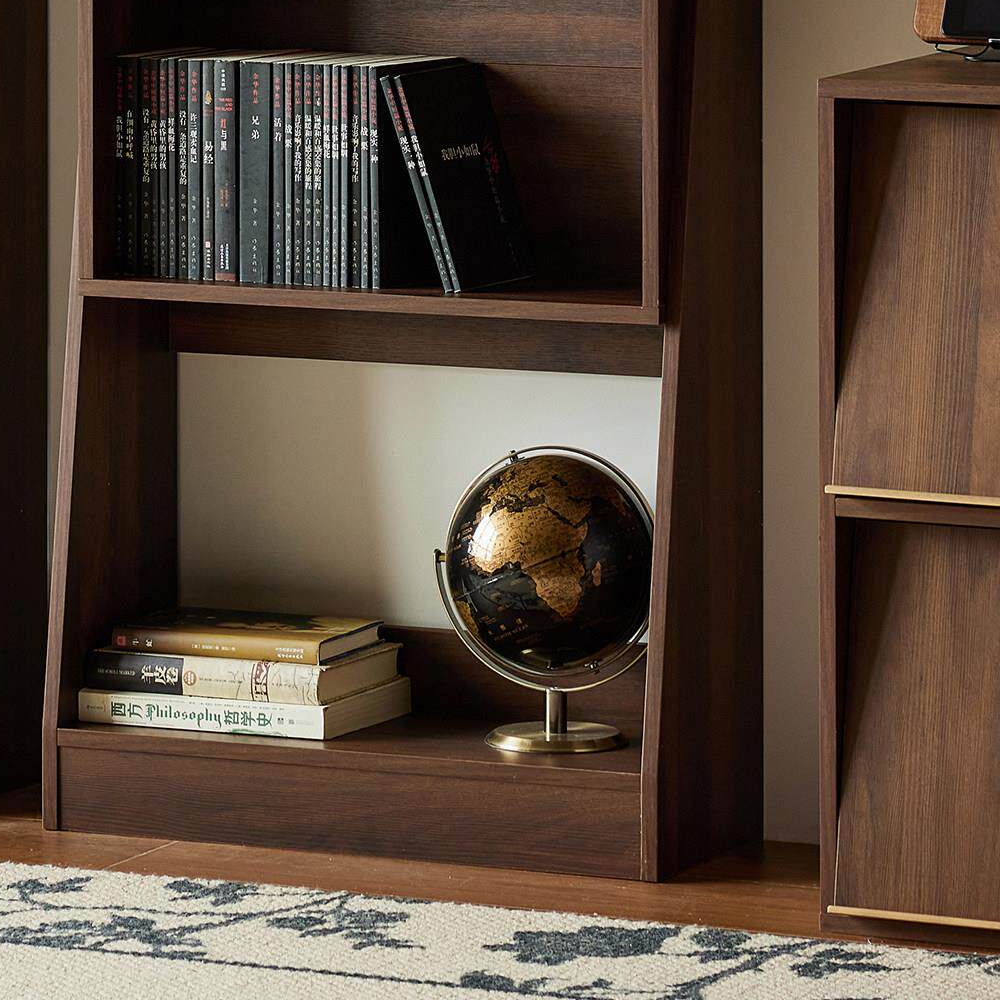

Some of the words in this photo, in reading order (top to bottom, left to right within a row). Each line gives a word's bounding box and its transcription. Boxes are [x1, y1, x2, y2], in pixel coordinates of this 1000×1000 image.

[251, 115, 260, 140] 兄弟
[273, 117, 282, 142] 活着
[203, 140, 214, 164] 易经
[141, 664, 180, 687] 羊皮卷
[111, 700, 144, 718] 西方
[145, 703, 223, 728] Philosophy
[223, 709, 273, 728] 哲学史
